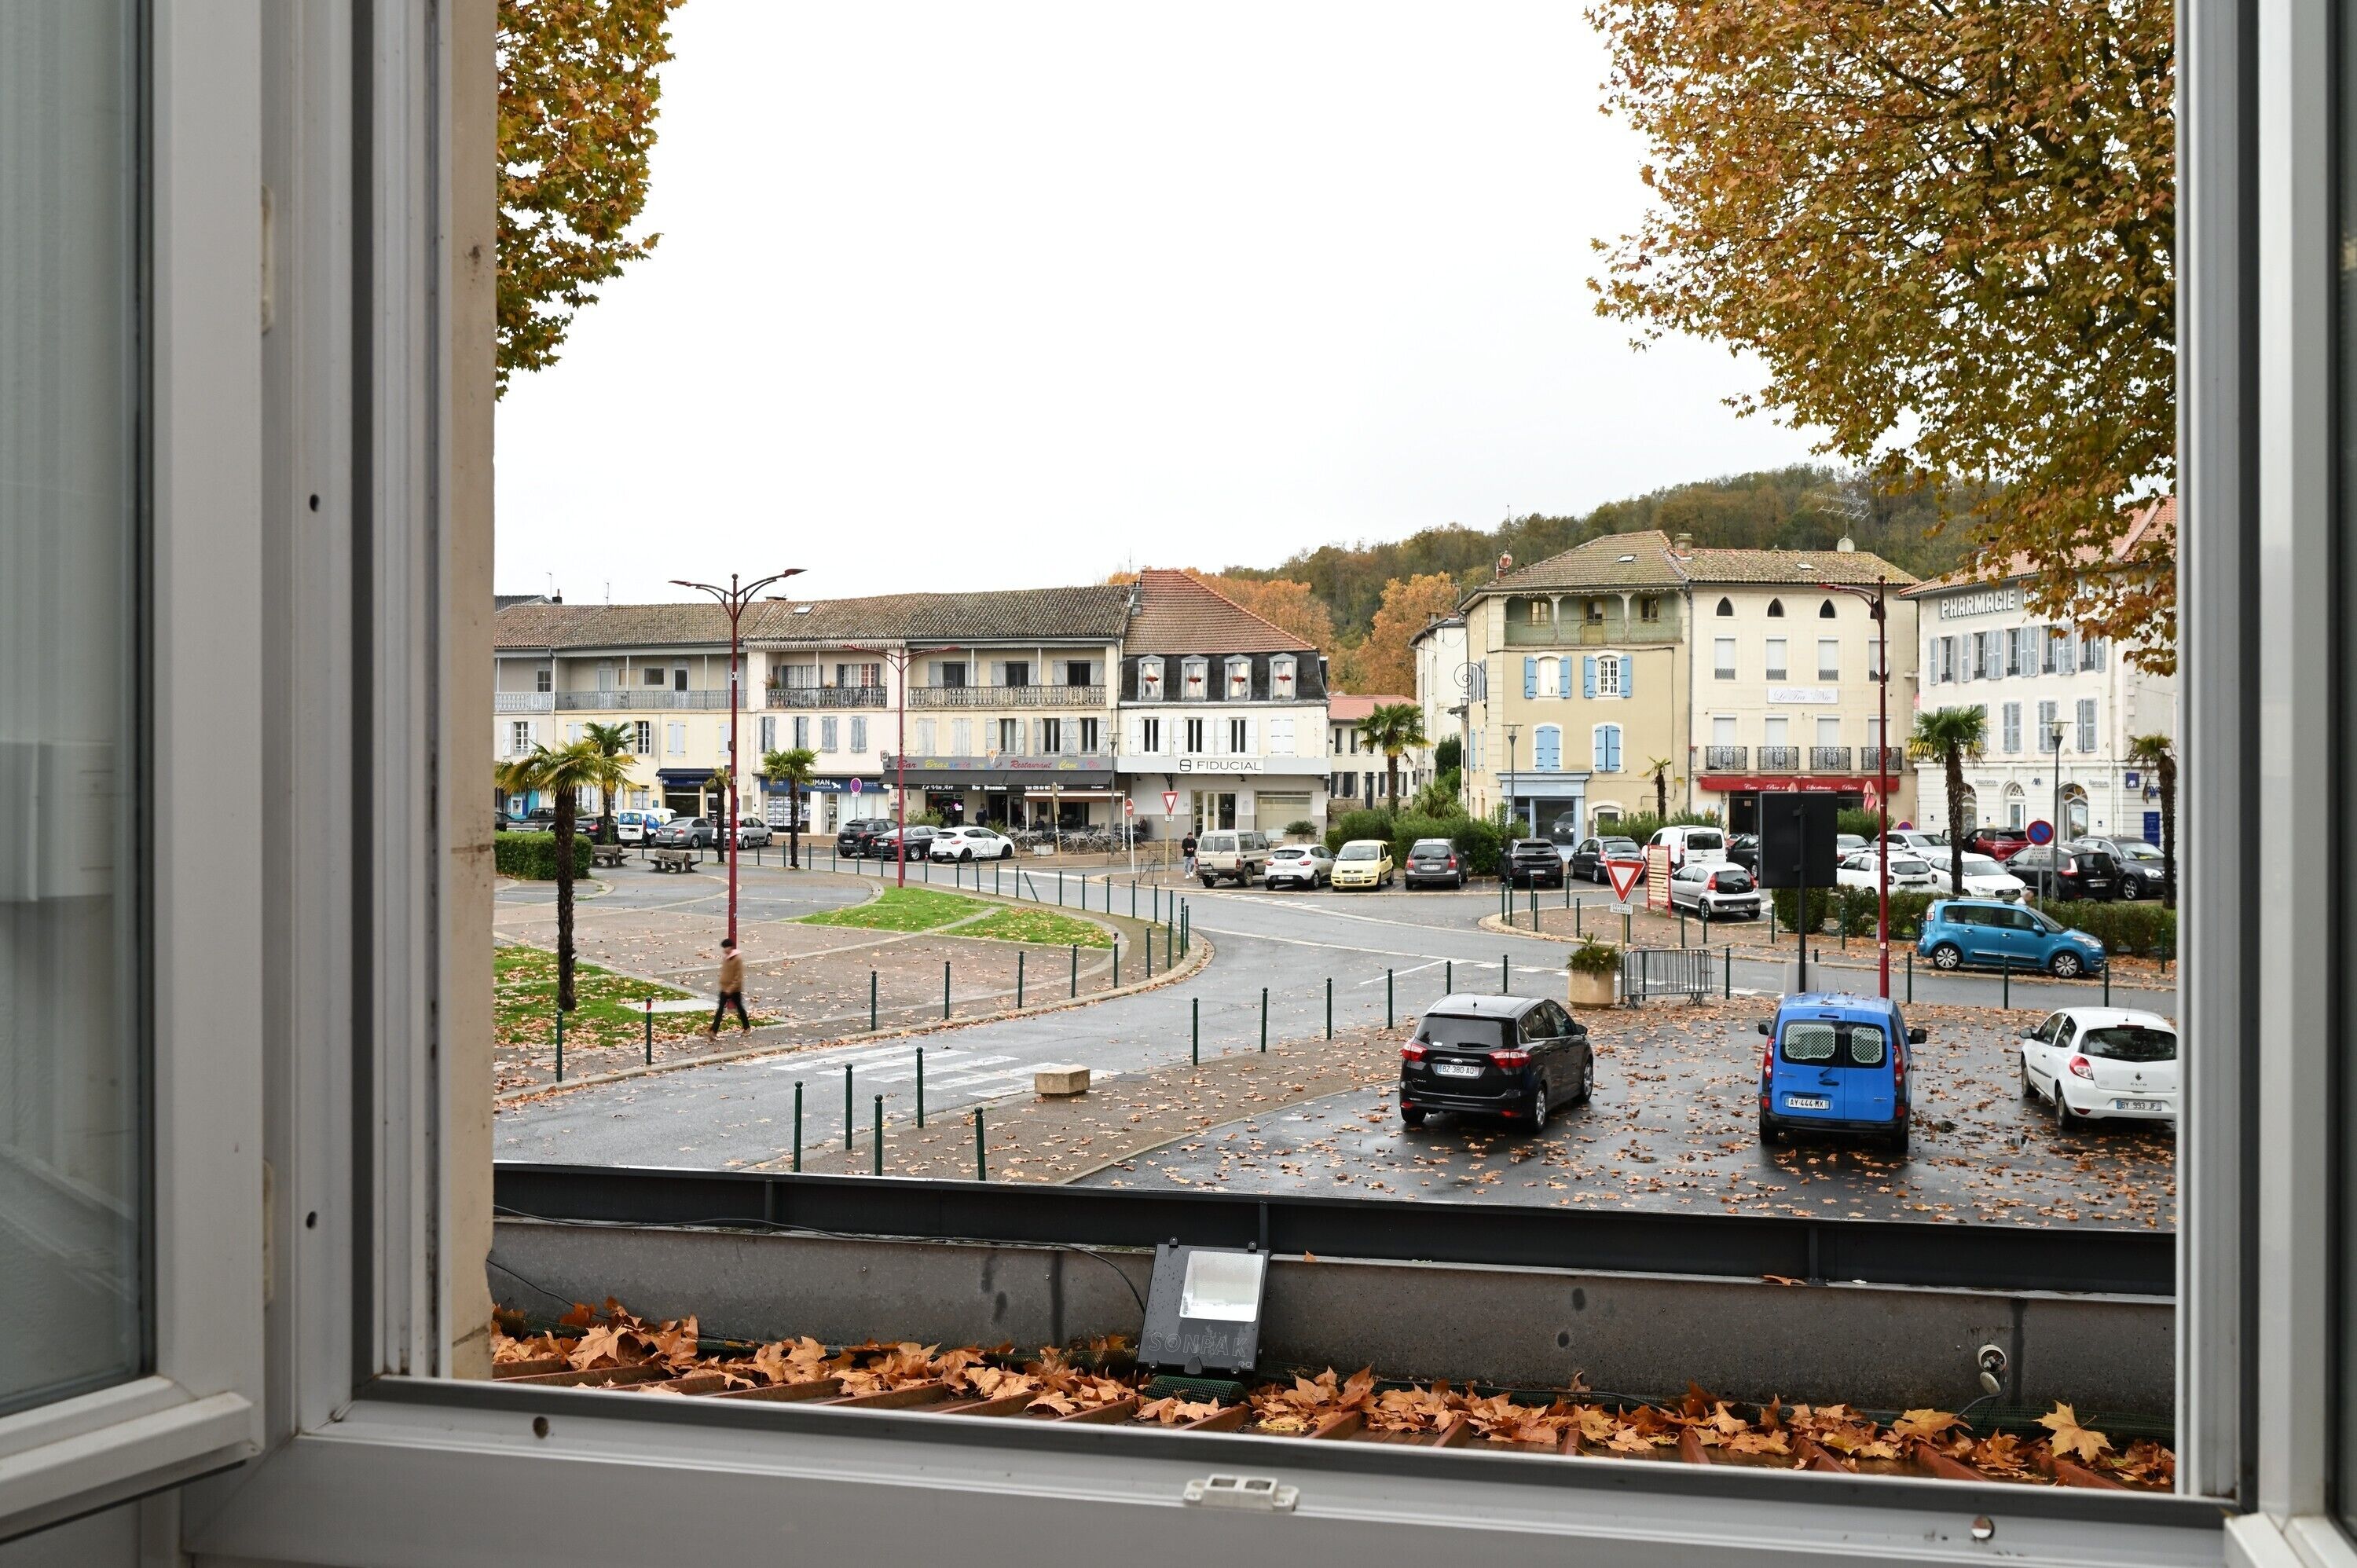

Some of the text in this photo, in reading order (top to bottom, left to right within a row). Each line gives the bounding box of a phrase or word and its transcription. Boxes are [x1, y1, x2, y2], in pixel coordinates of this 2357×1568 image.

[1941, 590, 2015, 619] PHARMACIE
[1010, 760, 1053, 769] Restaurant
[1197, 760, 1263, 771] FIDUCIAL
[1149, 1332, 1248, 1357] SONPAK
